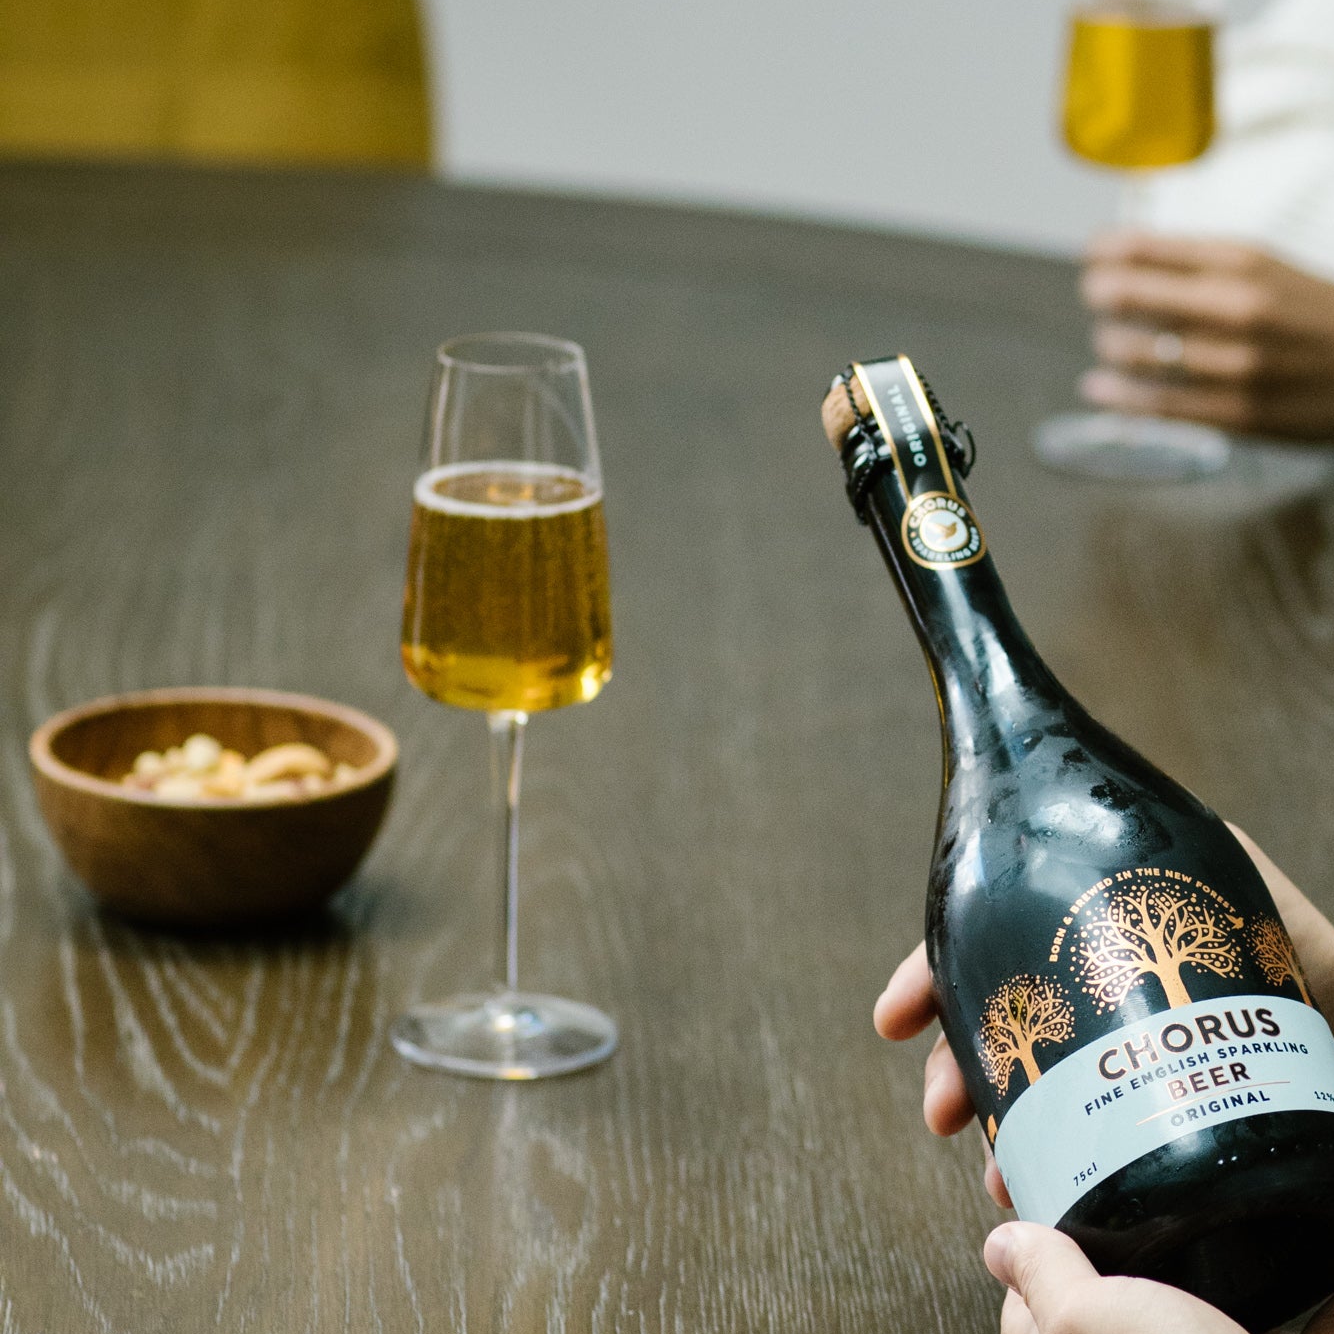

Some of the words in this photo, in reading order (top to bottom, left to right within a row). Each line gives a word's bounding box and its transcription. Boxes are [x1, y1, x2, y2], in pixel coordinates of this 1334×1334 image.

[888, 384, 927, 467] ORIGINAL
[908, 497, 967, 529] CHORUS
[1049, 927, 1067, 962] BORN
[1062, 916, 1073, 925] &
[1069, 877, 1113, 914] BREWED
[1115, 870, 1132, 882] IN
[1135, 867, 1160, 877] THE
[1165, 869, 1192, 883] NEW
[1195, 880, 1236, 913] FOREST
[1098, 1008, 1281, 1081] CHORUS
[1084, 1086, 1124, 1116] FINE
[1130, 1053, 1210, 1091] ENGLISH
[1217, 1041, 1309, 1060] SPARKLING
[1166, 1061, 1251, 1101] BEER
[1170, 1090, 1271, 1127] ORIGINAL
[1073, 1162, 1098, 1187] 75cl
